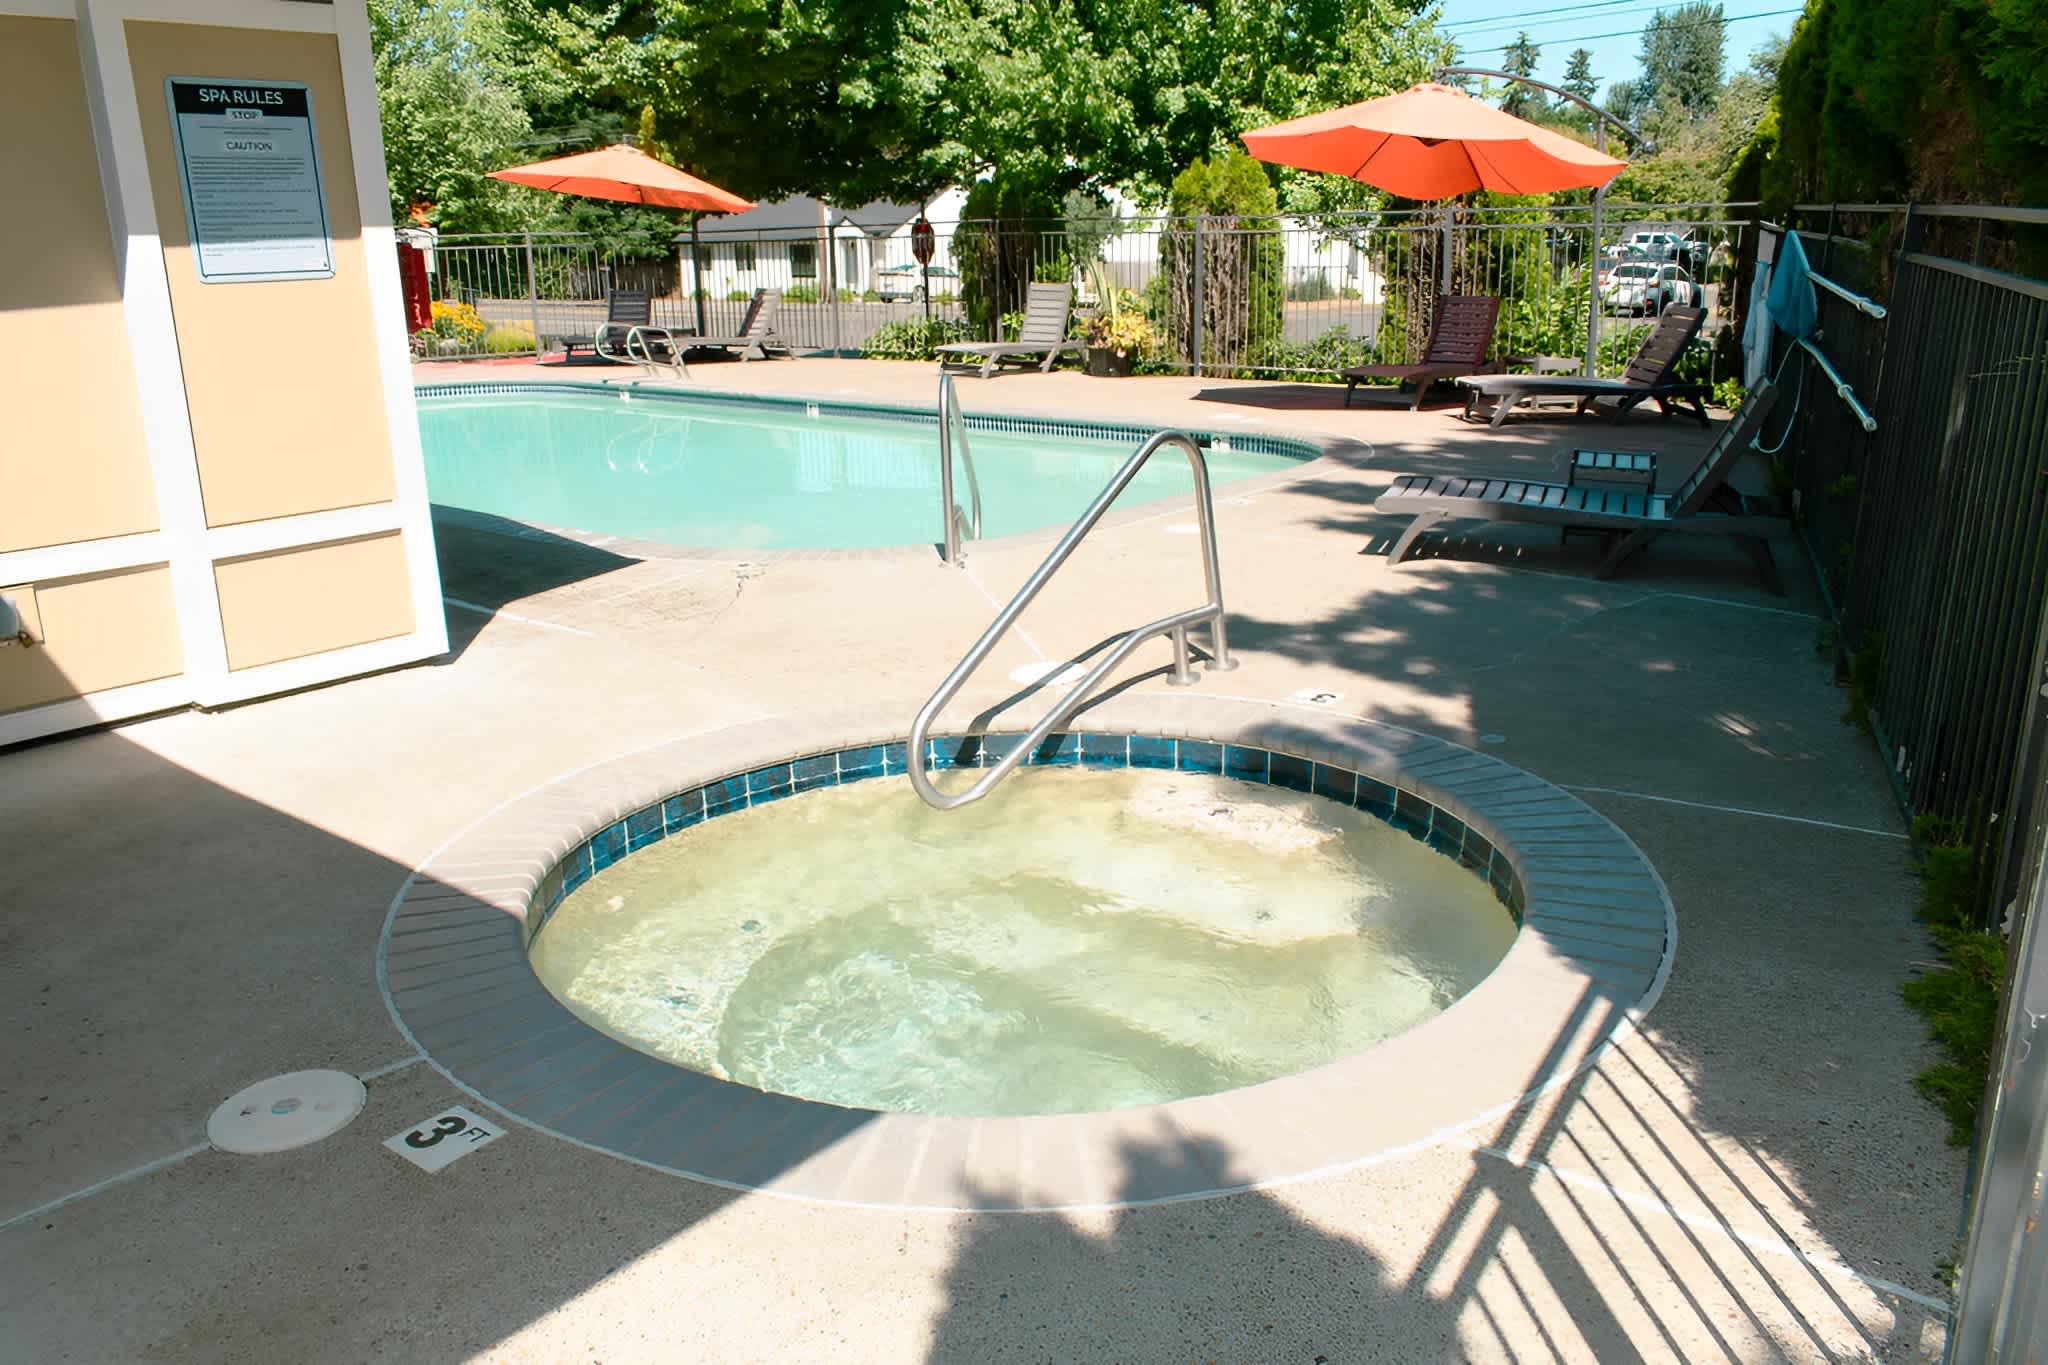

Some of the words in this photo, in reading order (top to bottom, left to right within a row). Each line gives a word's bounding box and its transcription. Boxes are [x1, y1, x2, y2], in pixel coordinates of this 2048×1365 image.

[199, 88, 232, 104] SPA
[233, 90, 284, 105] RULES
[226, 141, 273, 151] CAUTION
[405, 1116, 467, 1148] 3
[459, 1127, 491, 1143] FT
